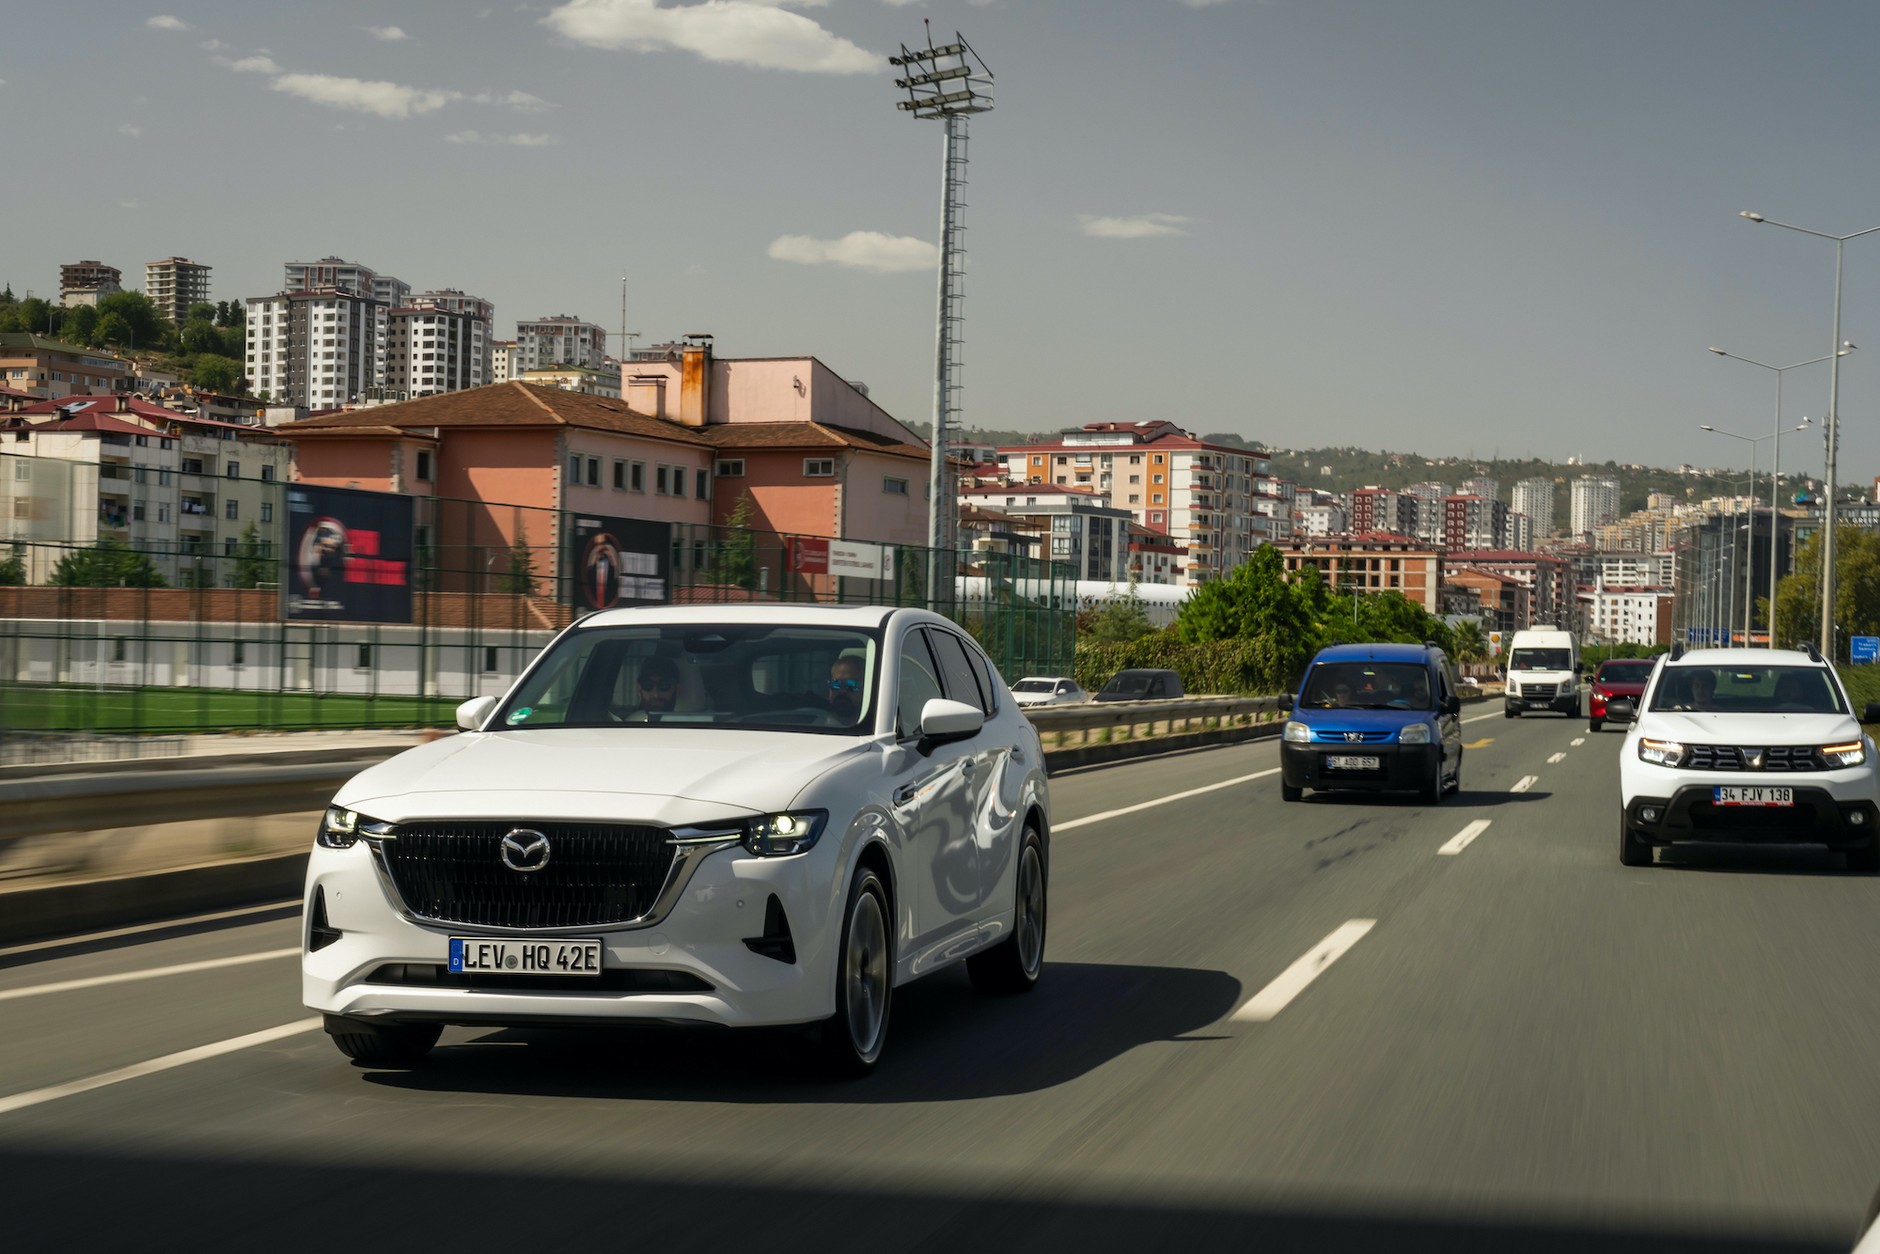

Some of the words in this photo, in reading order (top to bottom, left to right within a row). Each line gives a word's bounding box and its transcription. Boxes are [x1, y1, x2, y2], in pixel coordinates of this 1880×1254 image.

[1721, 788, 1735, 800] 34
[1741, 788, 1763, 801] FJV
[1769, 788, 1790, 801] 138
[453, 958, 459, 966] D
[464, 943, 505, 969] LEV
[522, 945, 550, 970] HQ
[556, 945, 598, 970] 42E
